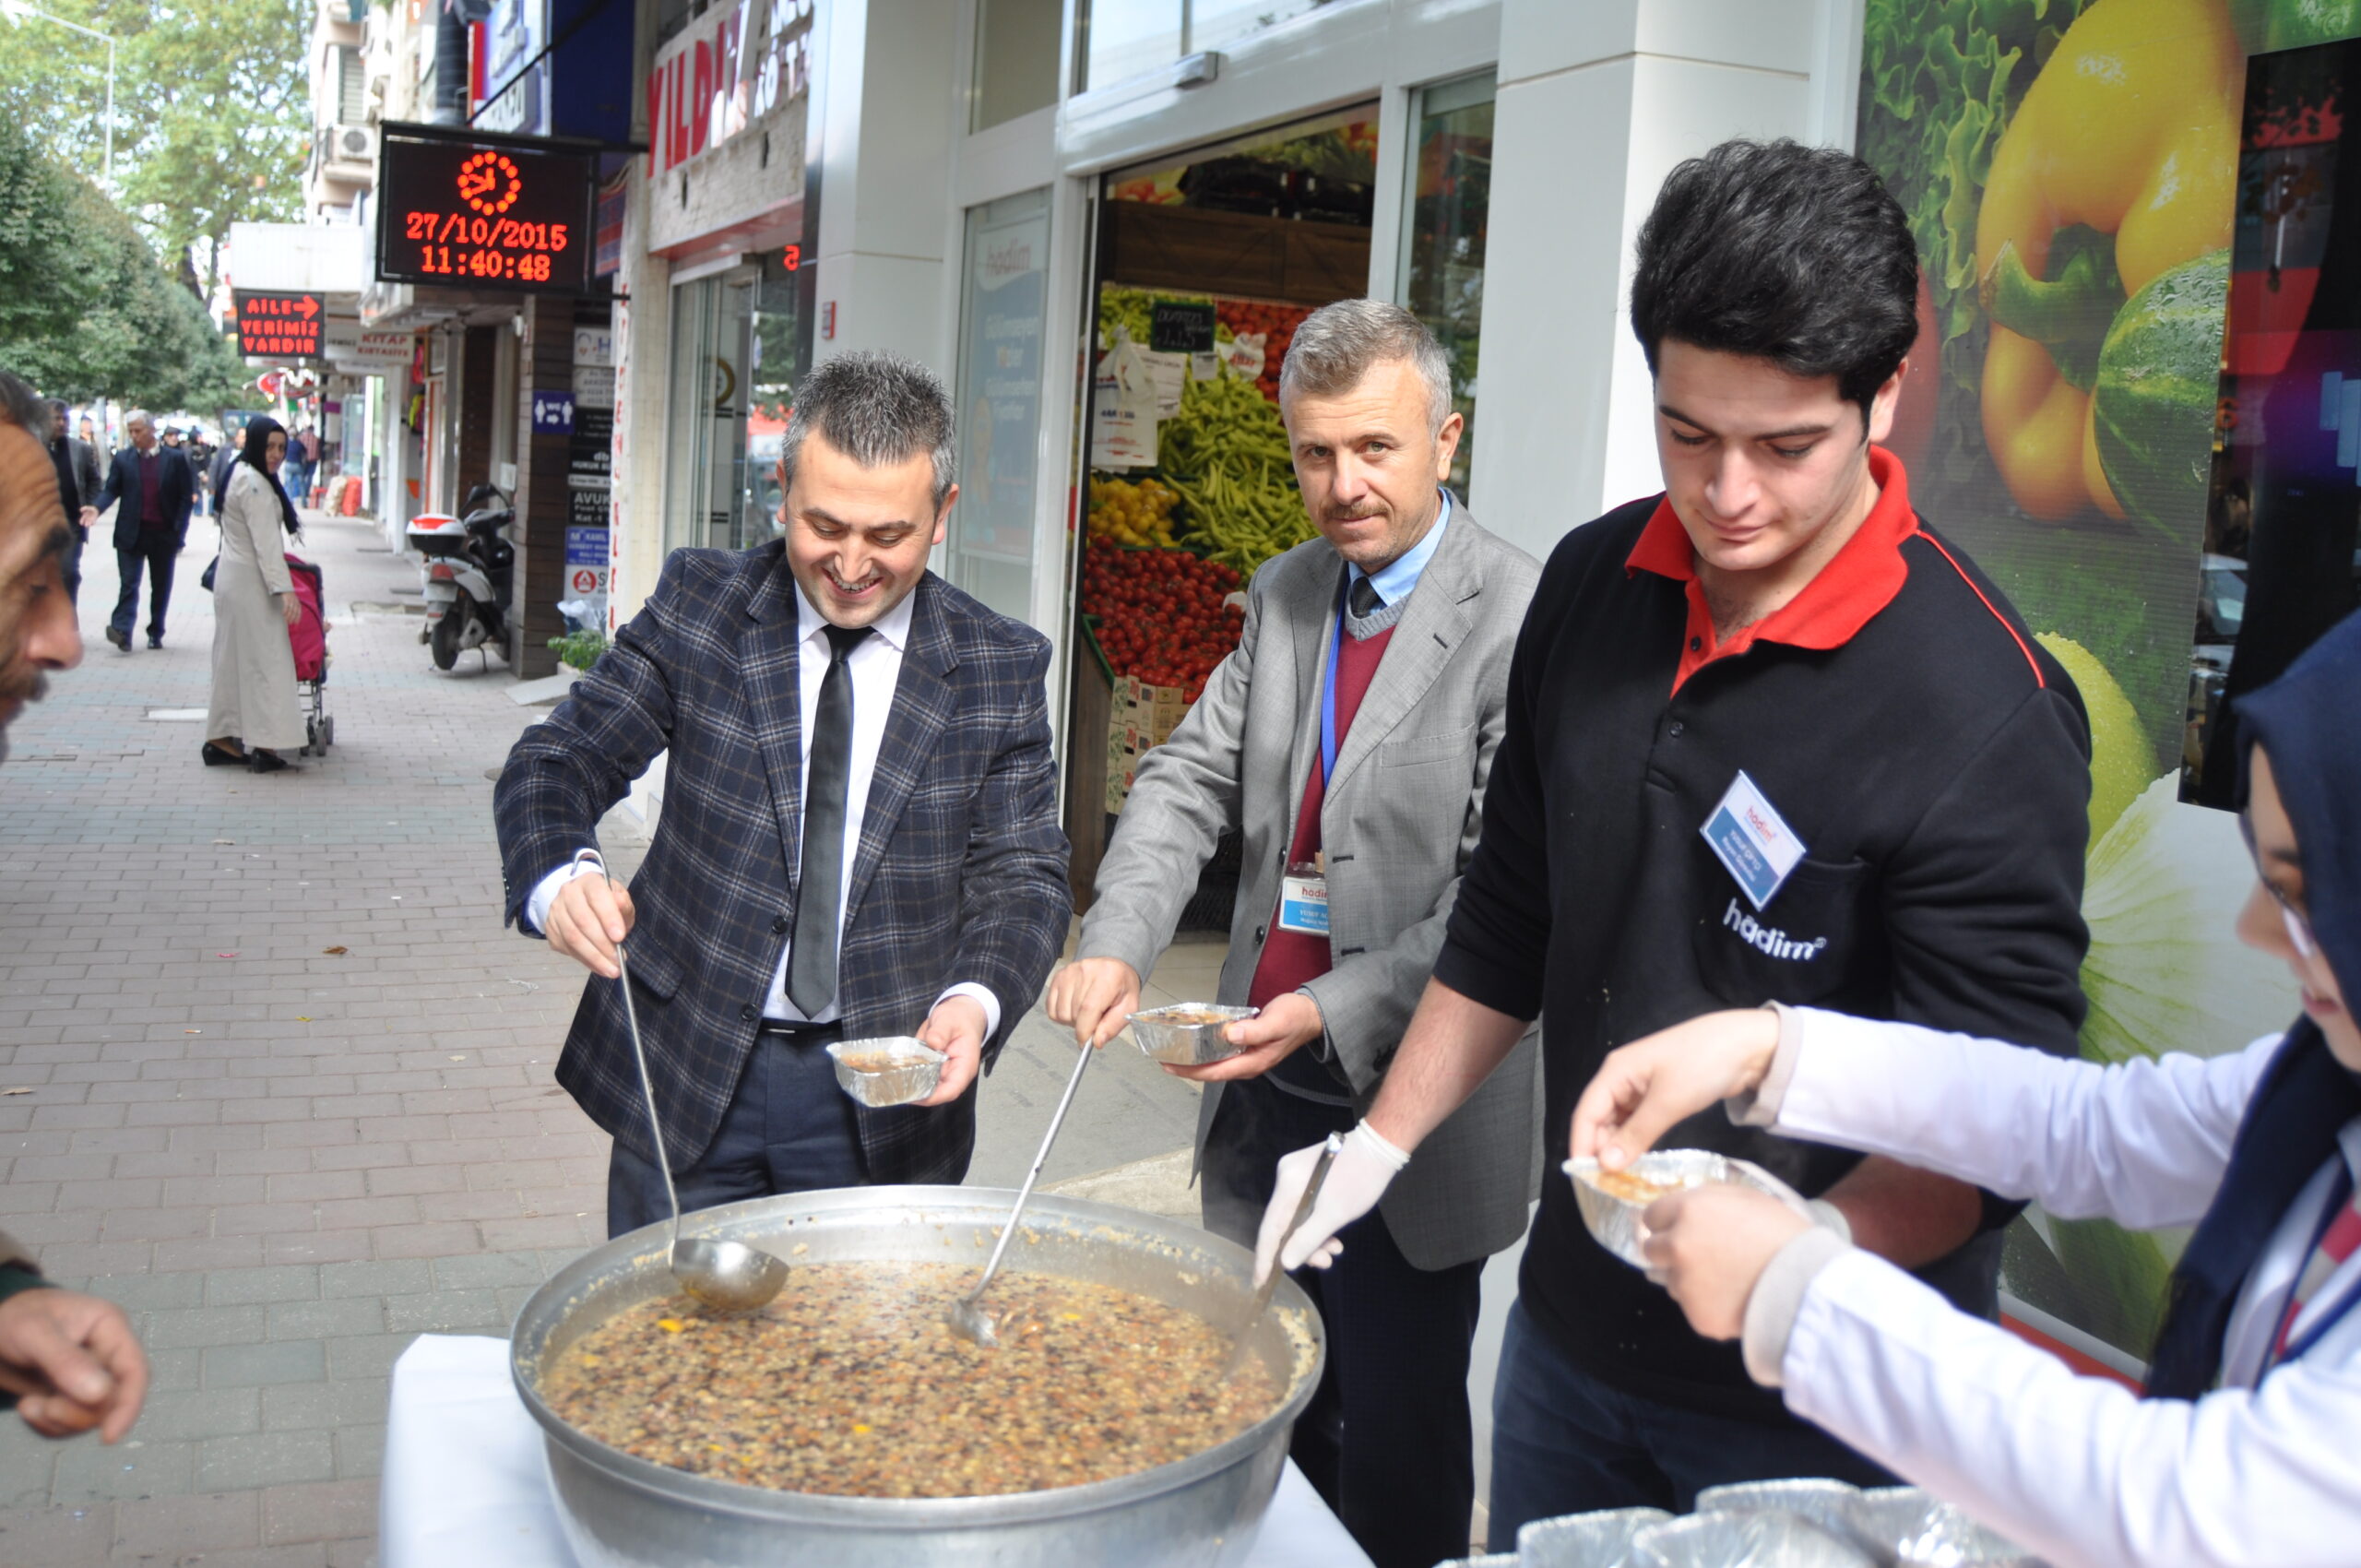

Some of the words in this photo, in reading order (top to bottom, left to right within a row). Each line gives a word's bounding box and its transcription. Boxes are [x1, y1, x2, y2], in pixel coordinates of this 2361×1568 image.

[406, 211, 567, 252] 27/10/2015
[421, 244, 551, 281] 11:40:48
[243, 337, 315, 354] VARDIR
